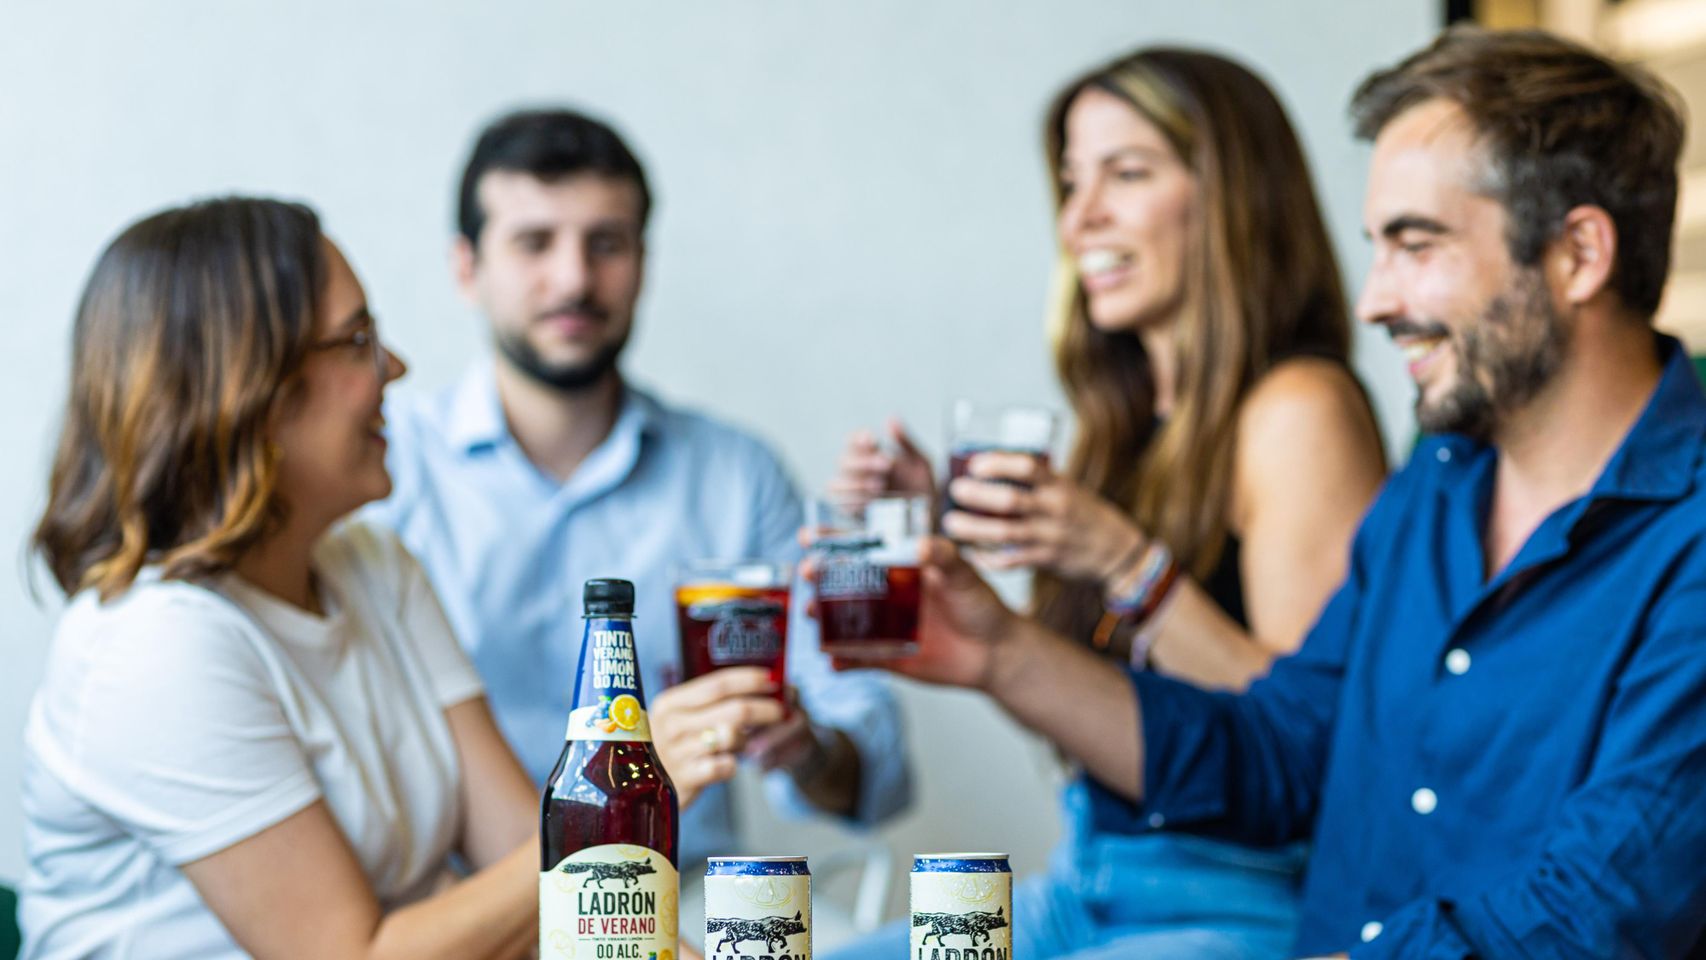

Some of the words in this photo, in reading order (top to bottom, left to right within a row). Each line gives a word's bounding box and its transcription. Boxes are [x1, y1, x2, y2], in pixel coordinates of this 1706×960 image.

[593, 630, 633, 648] TINTO
[593, 647, 634, 660] VERANO
[593, 660, 635, 676] LIMÓN
[613, 675, 637, 690] ALC.
[578, 888, 655, 915] LADRÓN
[578, 918, 595, 934] DE
[601, 917, 656, 934] VERANO
[617, 943, 643, 959] ALC.
